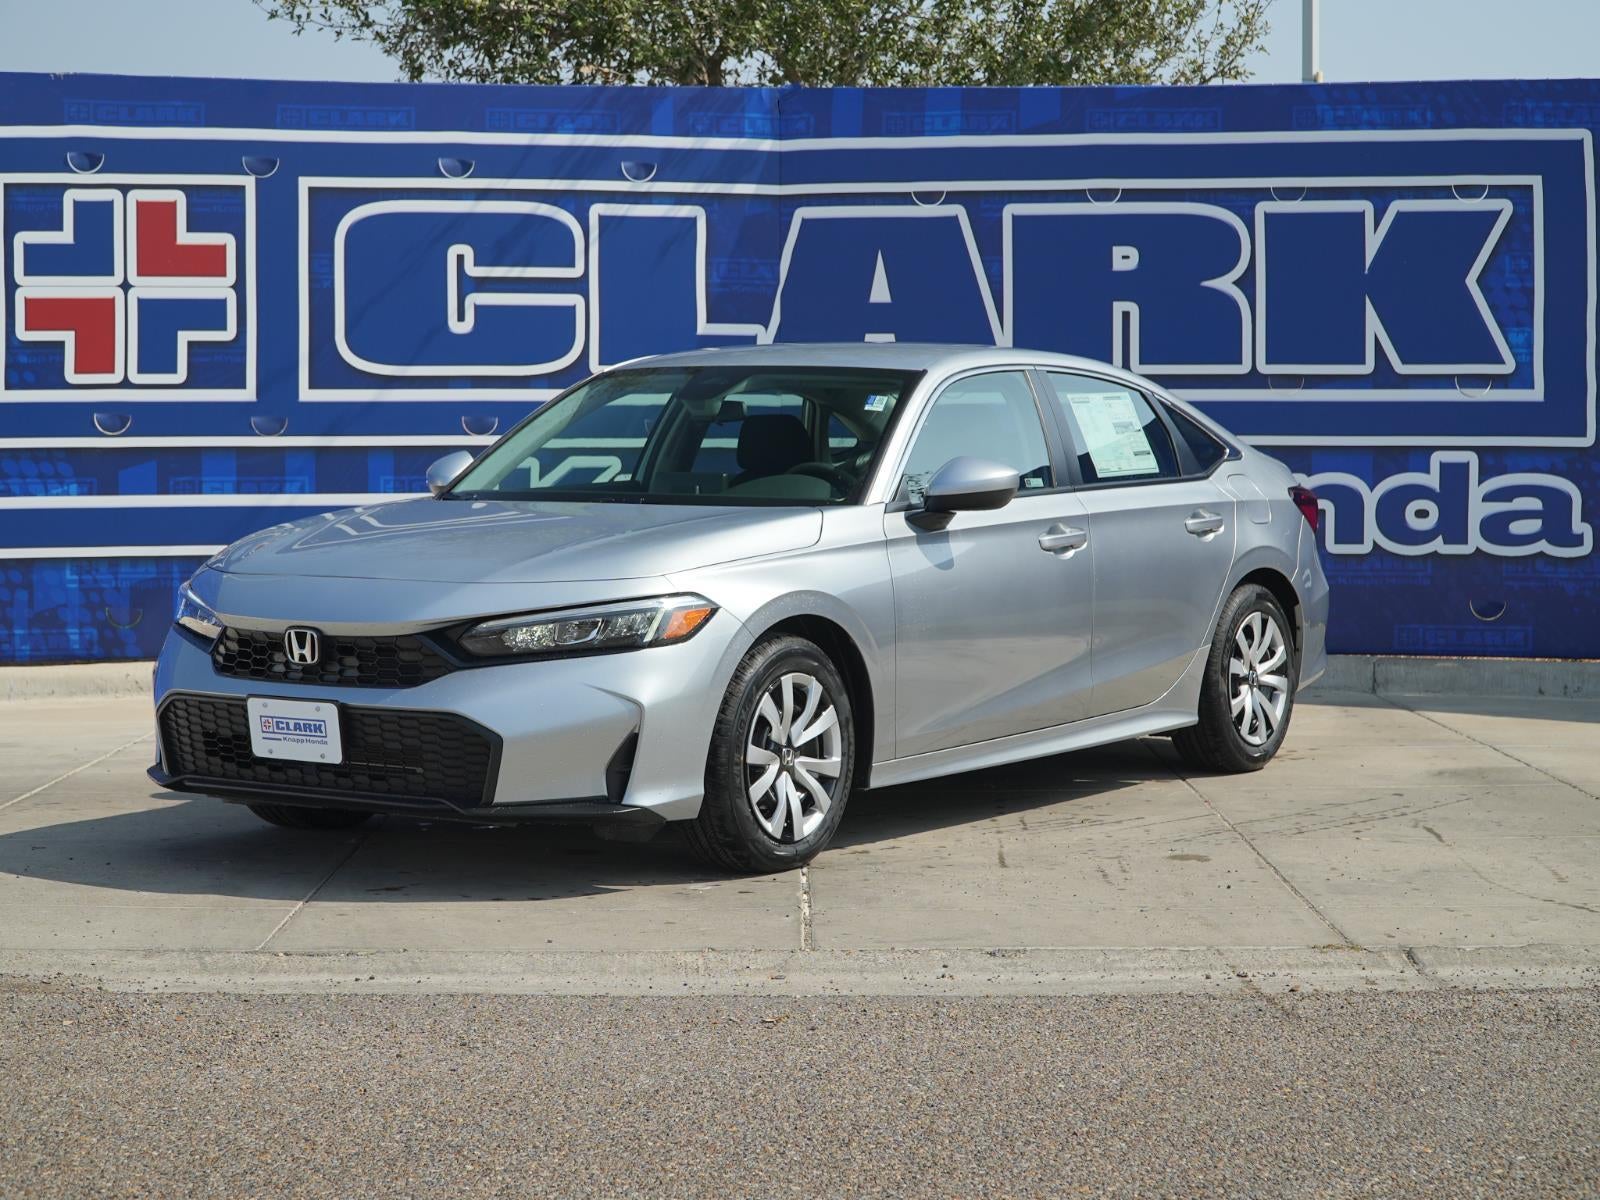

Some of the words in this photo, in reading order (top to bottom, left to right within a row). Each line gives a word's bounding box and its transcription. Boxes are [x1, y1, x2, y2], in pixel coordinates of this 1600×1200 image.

[333, 198, 1516, 379] CLARK
[1292, 450, 1594, 558] nda
[275, 720, 324, 733] CLARK
[282, 736, 305, 744] Knapp
[305, 737, 328, 745] Honda
